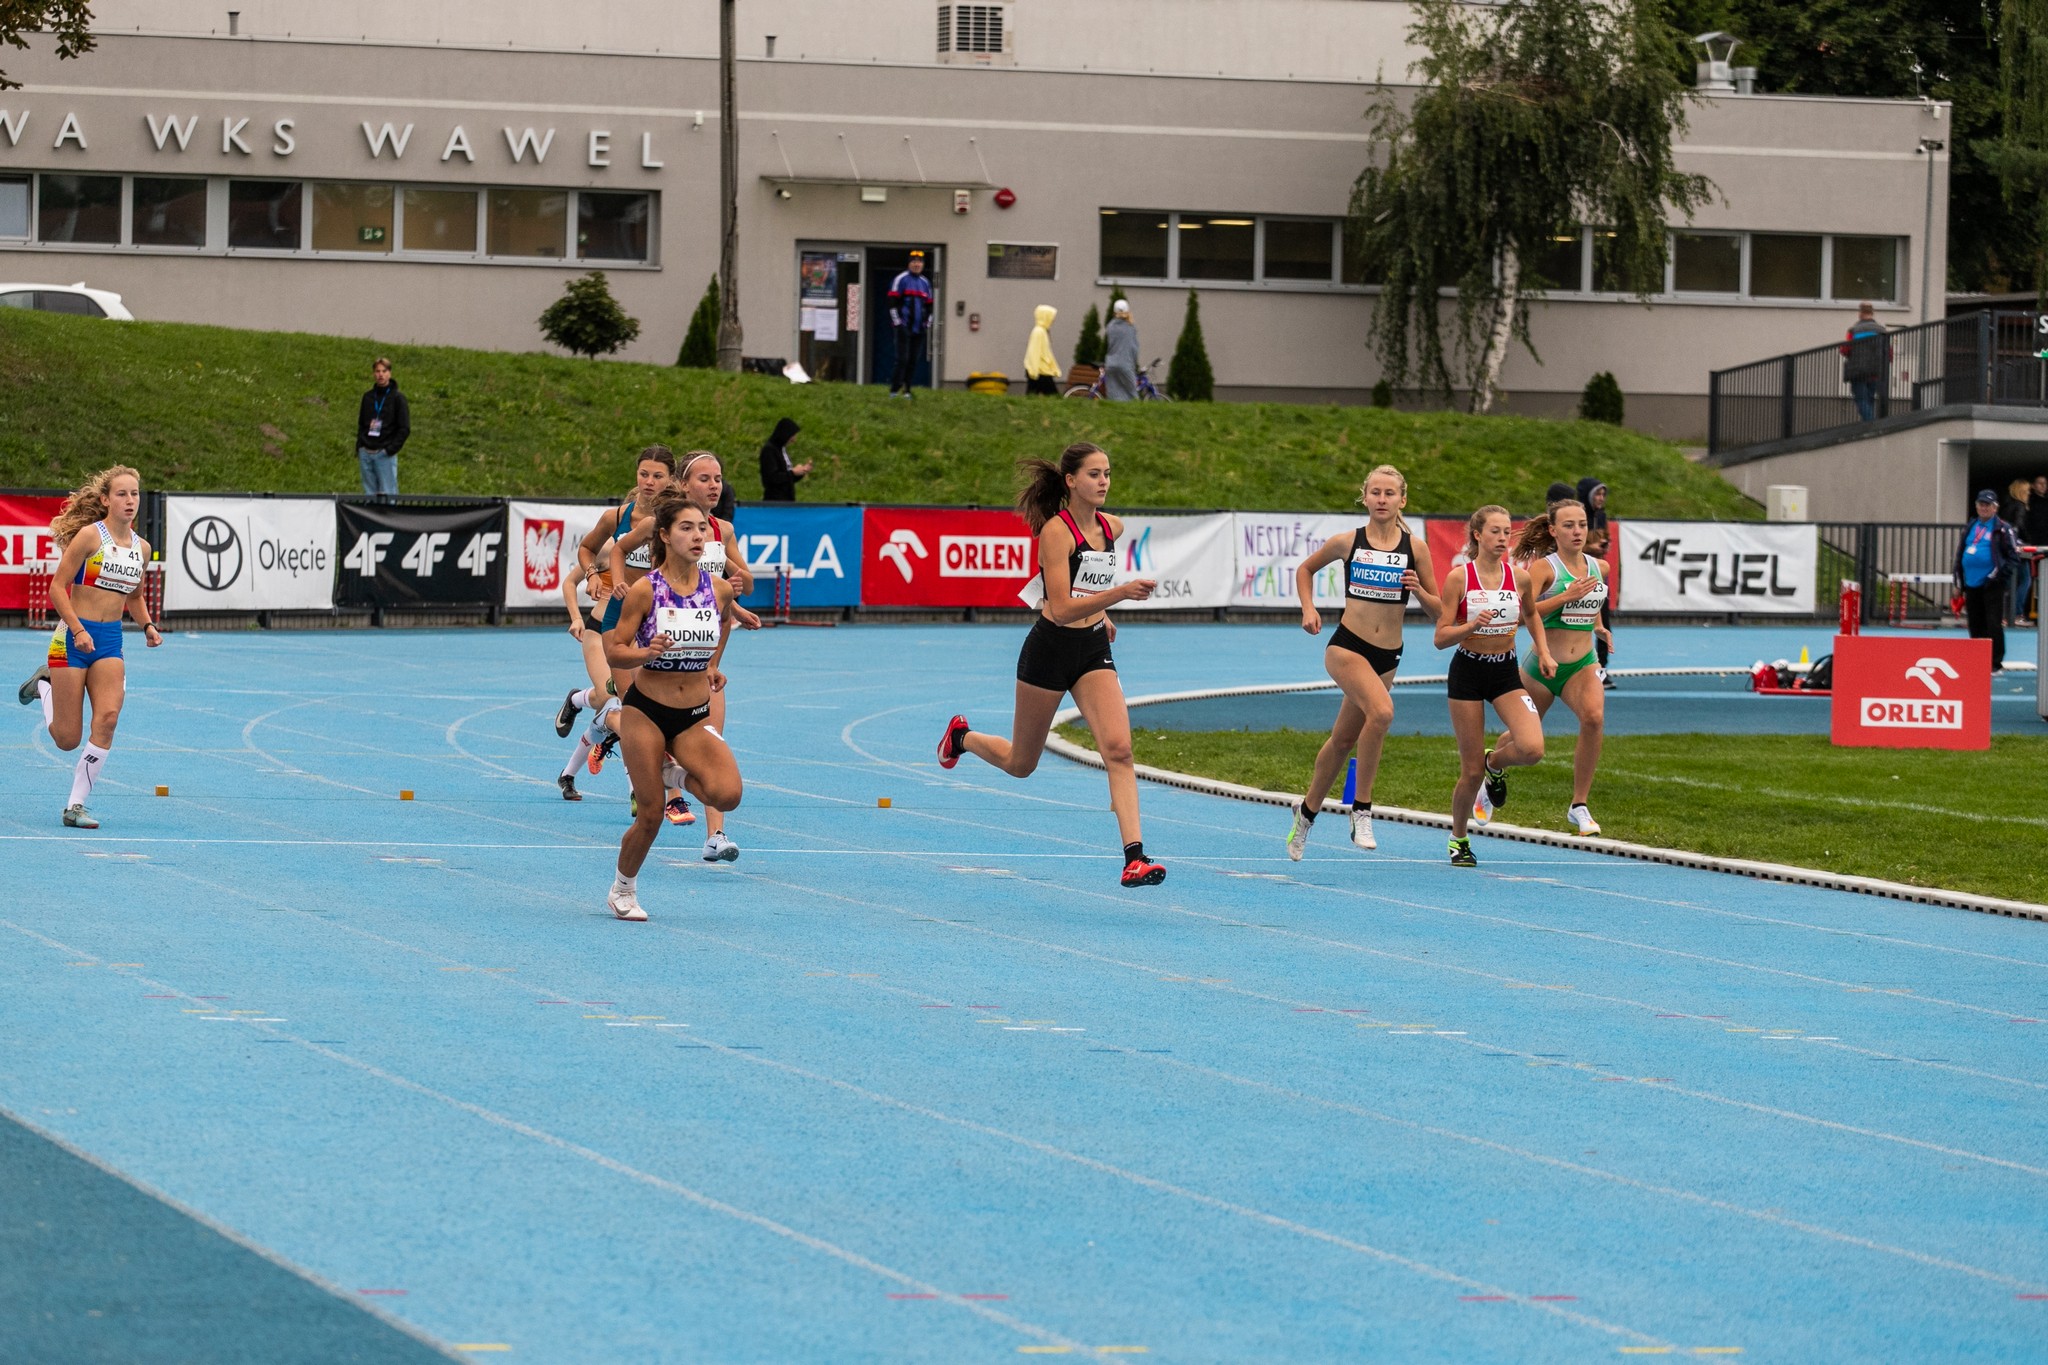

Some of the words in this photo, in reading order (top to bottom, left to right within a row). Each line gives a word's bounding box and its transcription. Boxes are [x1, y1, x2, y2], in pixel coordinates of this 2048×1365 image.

[146, 114, 298, 156] WKS
[362, 121, 665, 168] WAWEL
[128, 551, 140, 561] 41
[258, 539, 326, 578] Okęcie
[344, 531, 395, 577] 4F
[401, 532, 451, 577] 4F
[457, 532, 502, 577] 4F
[946, 542, 1024, 570] ORLEN
[1386, 554, 1401, 566] 12
[1639, 539, 1681, 565] 4F
[1679, 554, 1797, 595] FUEL
[1081, 571, 1114, 585] MUCHA
[1242, 566, 1338, 597] HEALTER
[1354, 588, 1381, 597] KRAKÓW
[1498, 592, 1513, 601] 24
[695, 610, 712, 621] 49
[1867, 703, 1955, 724] ORLEN
